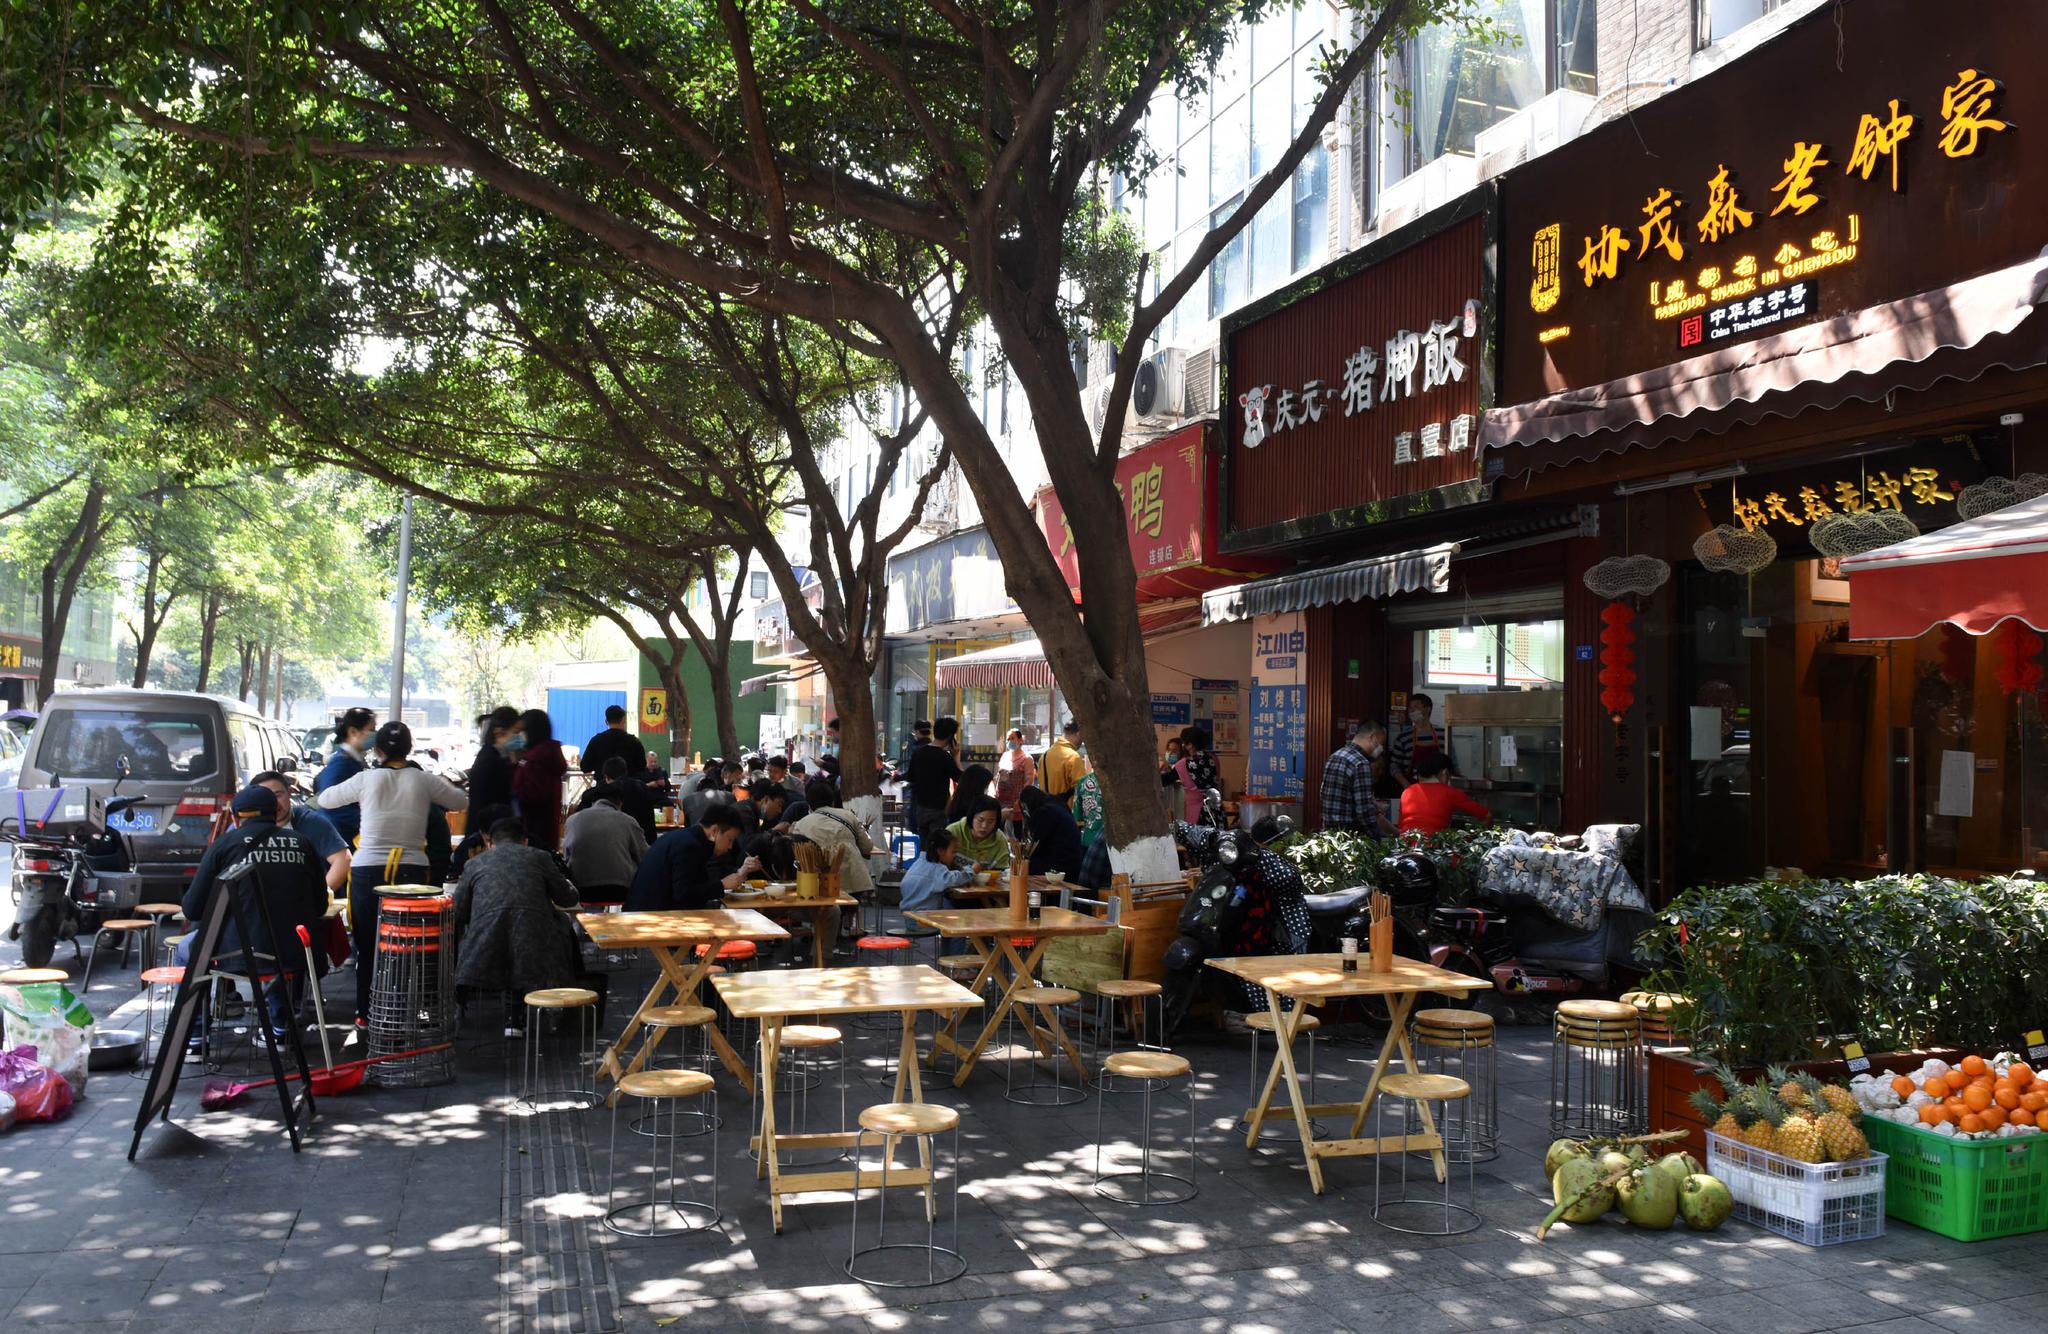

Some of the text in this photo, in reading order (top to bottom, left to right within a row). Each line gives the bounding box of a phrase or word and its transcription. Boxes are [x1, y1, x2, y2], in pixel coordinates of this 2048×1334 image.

[1655, 244, 1857, 320] FAMOUS SNACK IN CHENGDU
[1709, 283, 1807, 327] 中华老字号
[1710, 304, 1806, 340] China Time-honored Brand
[1394, 413, 1474, 465] 直营店
[1148, 543, 1173, 566] 连锁店
[1255, 630, 1306, 658] 江小白
[645, 695, 662, 716] 面
[243, 835, 300, 849] SATE
